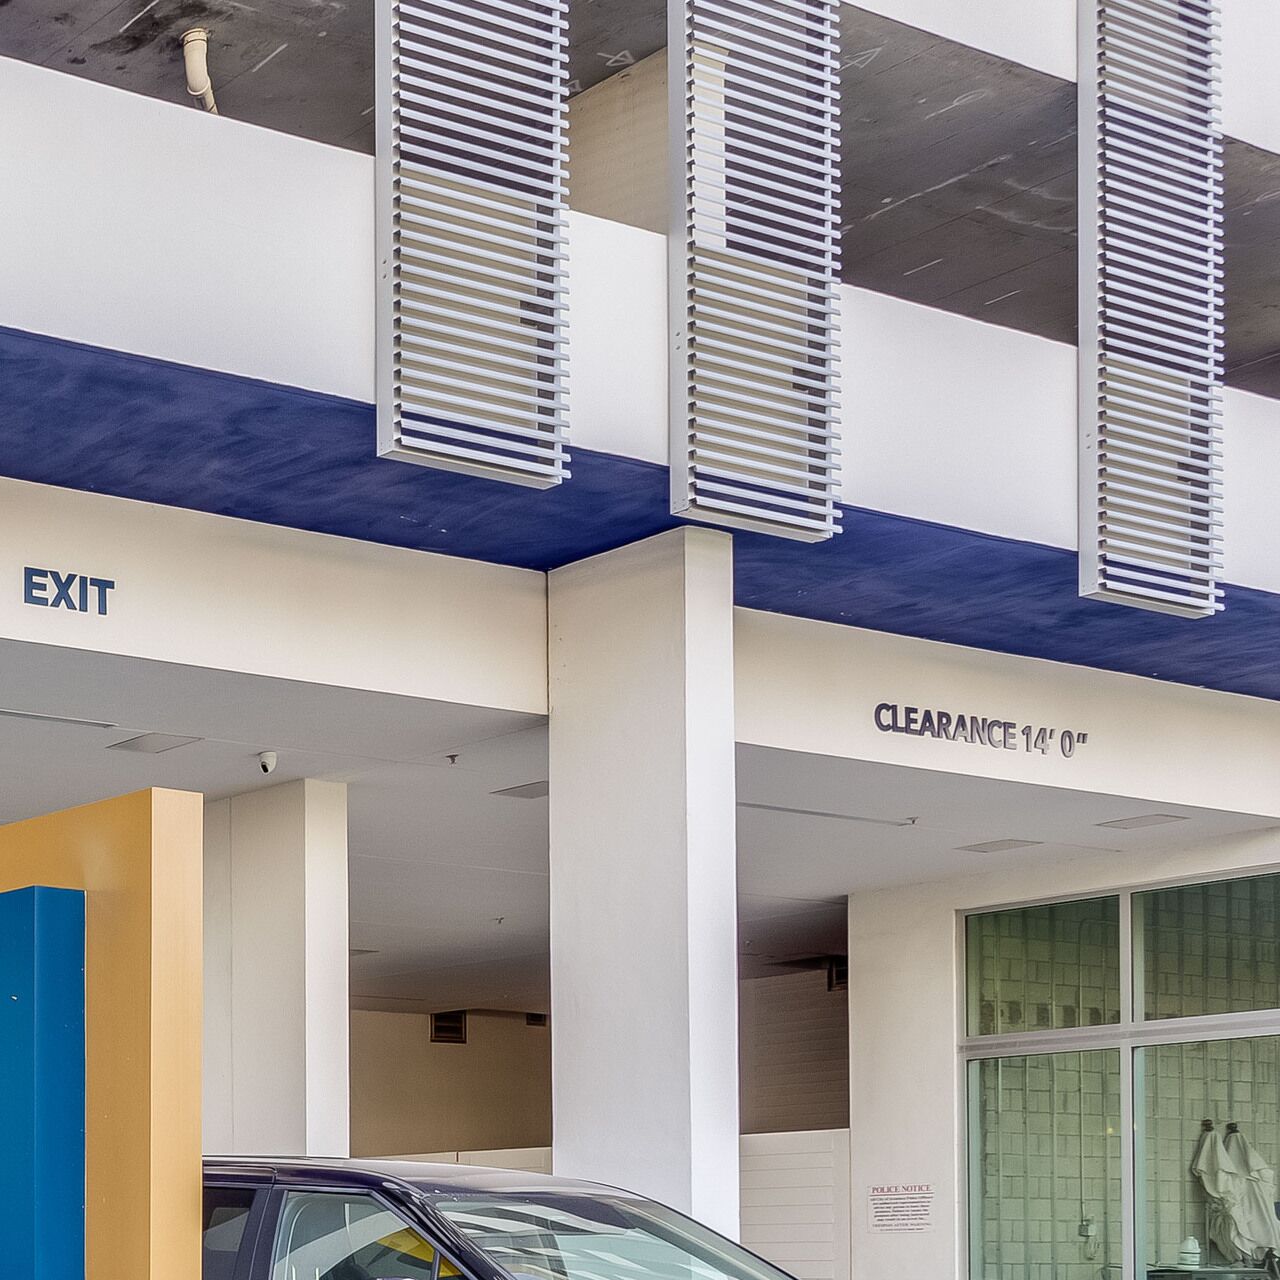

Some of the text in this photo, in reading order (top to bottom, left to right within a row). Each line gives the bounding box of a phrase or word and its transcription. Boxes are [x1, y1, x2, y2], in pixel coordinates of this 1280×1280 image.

[23, 566, 115, 616] EXIT
[874, 702, 1017, 750] CLEARANCE
[871, 1184, 932, 1194] POLICE NOTICE
